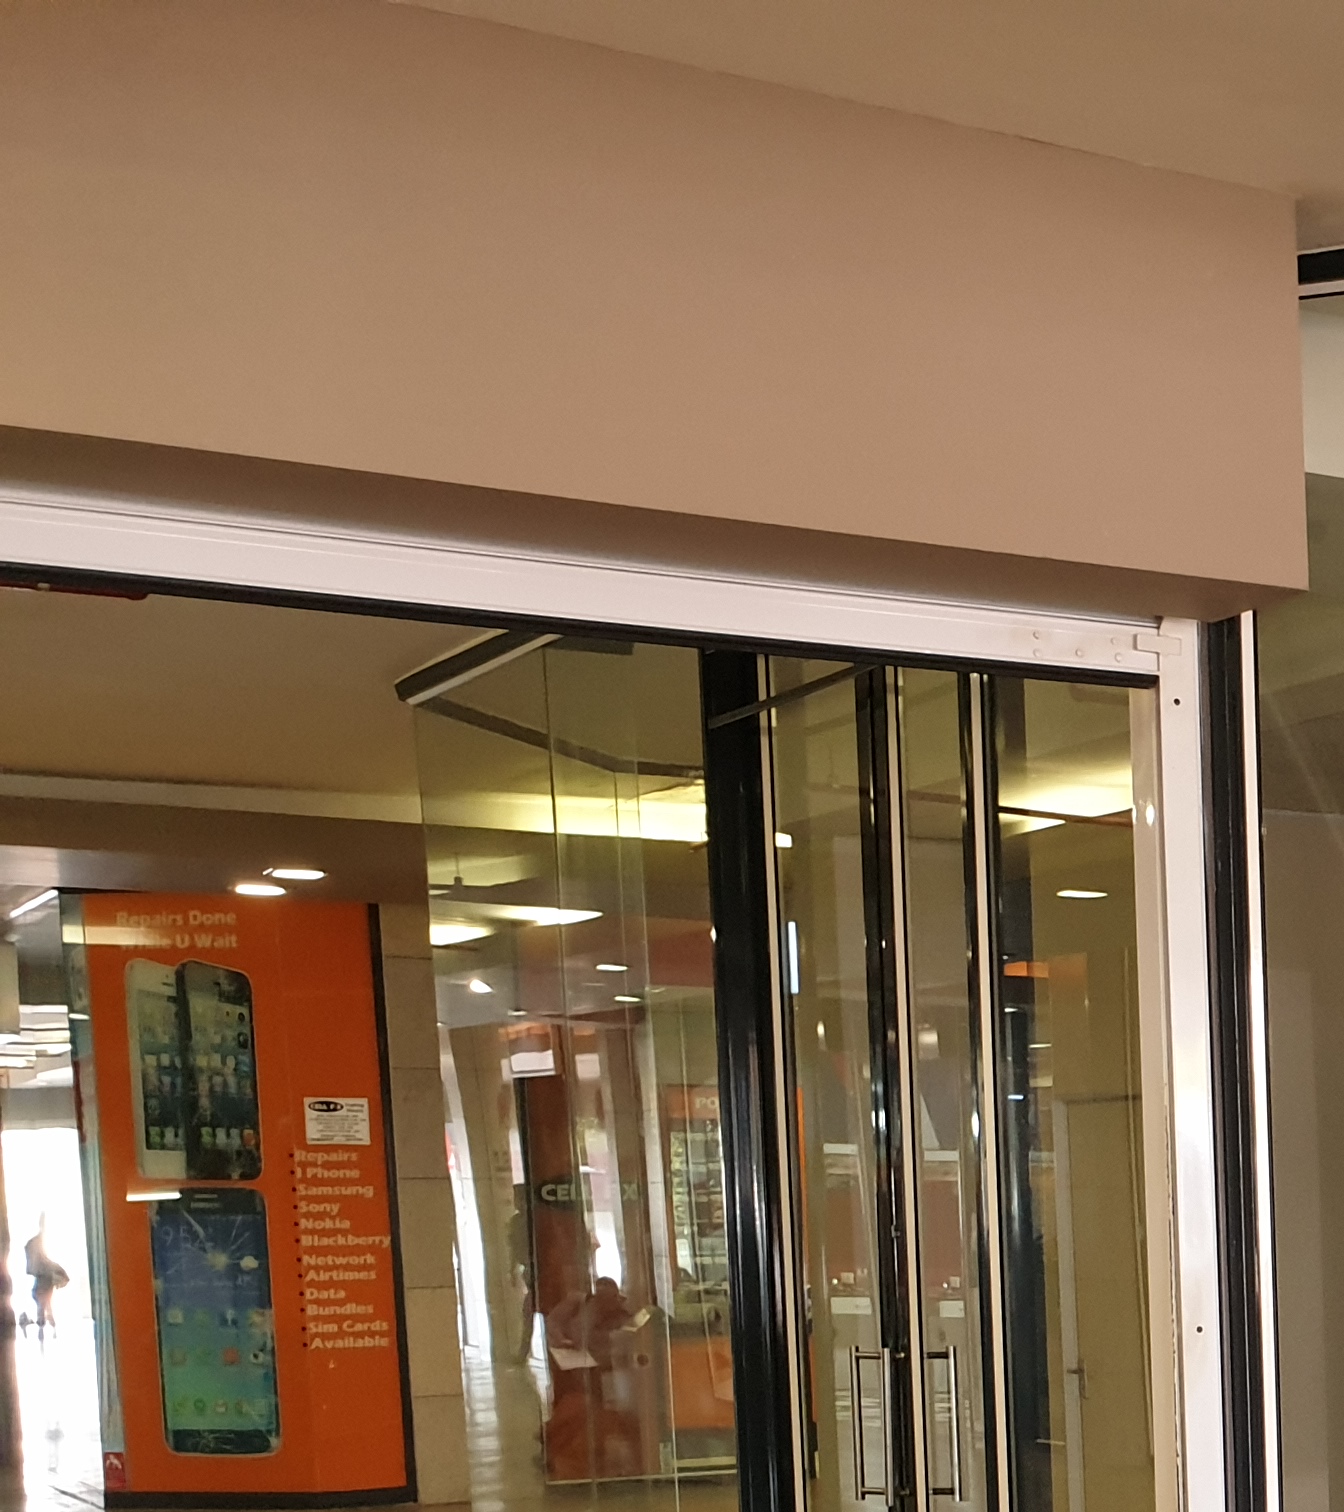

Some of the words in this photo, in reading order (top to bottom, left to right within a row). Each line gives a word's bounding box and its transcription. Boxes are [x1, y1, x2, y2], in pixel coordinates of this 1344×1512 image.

[116, 911, 184, 929] Repairs
[189, 910, 237, 926] Done
[175, 934, 190, 949] U
[194, 933, 238, 949] Wait
[294, 1150, 358, 1164] Repairs
[306, 1166, 361, 1178] Phone
[297, 1184, 374, 1198] Samsung
[300, 1201, 340, 1215] Sony
[300, 1218, 351, 1229] Nokia
[301, 1234, 391, 1248] Blackberry
[302, 1253, 375, 1266] Network
[305, 1270, 377, 1282] Airtimes
[305, 1288, 346, 1299] Data
[307, 1303, 374, 1315] Bundles
[309, 1321, 338, 1333] Sim
[342, 1320, 389, 1332] Cards
[310, 1336, 390, 1349] Available
